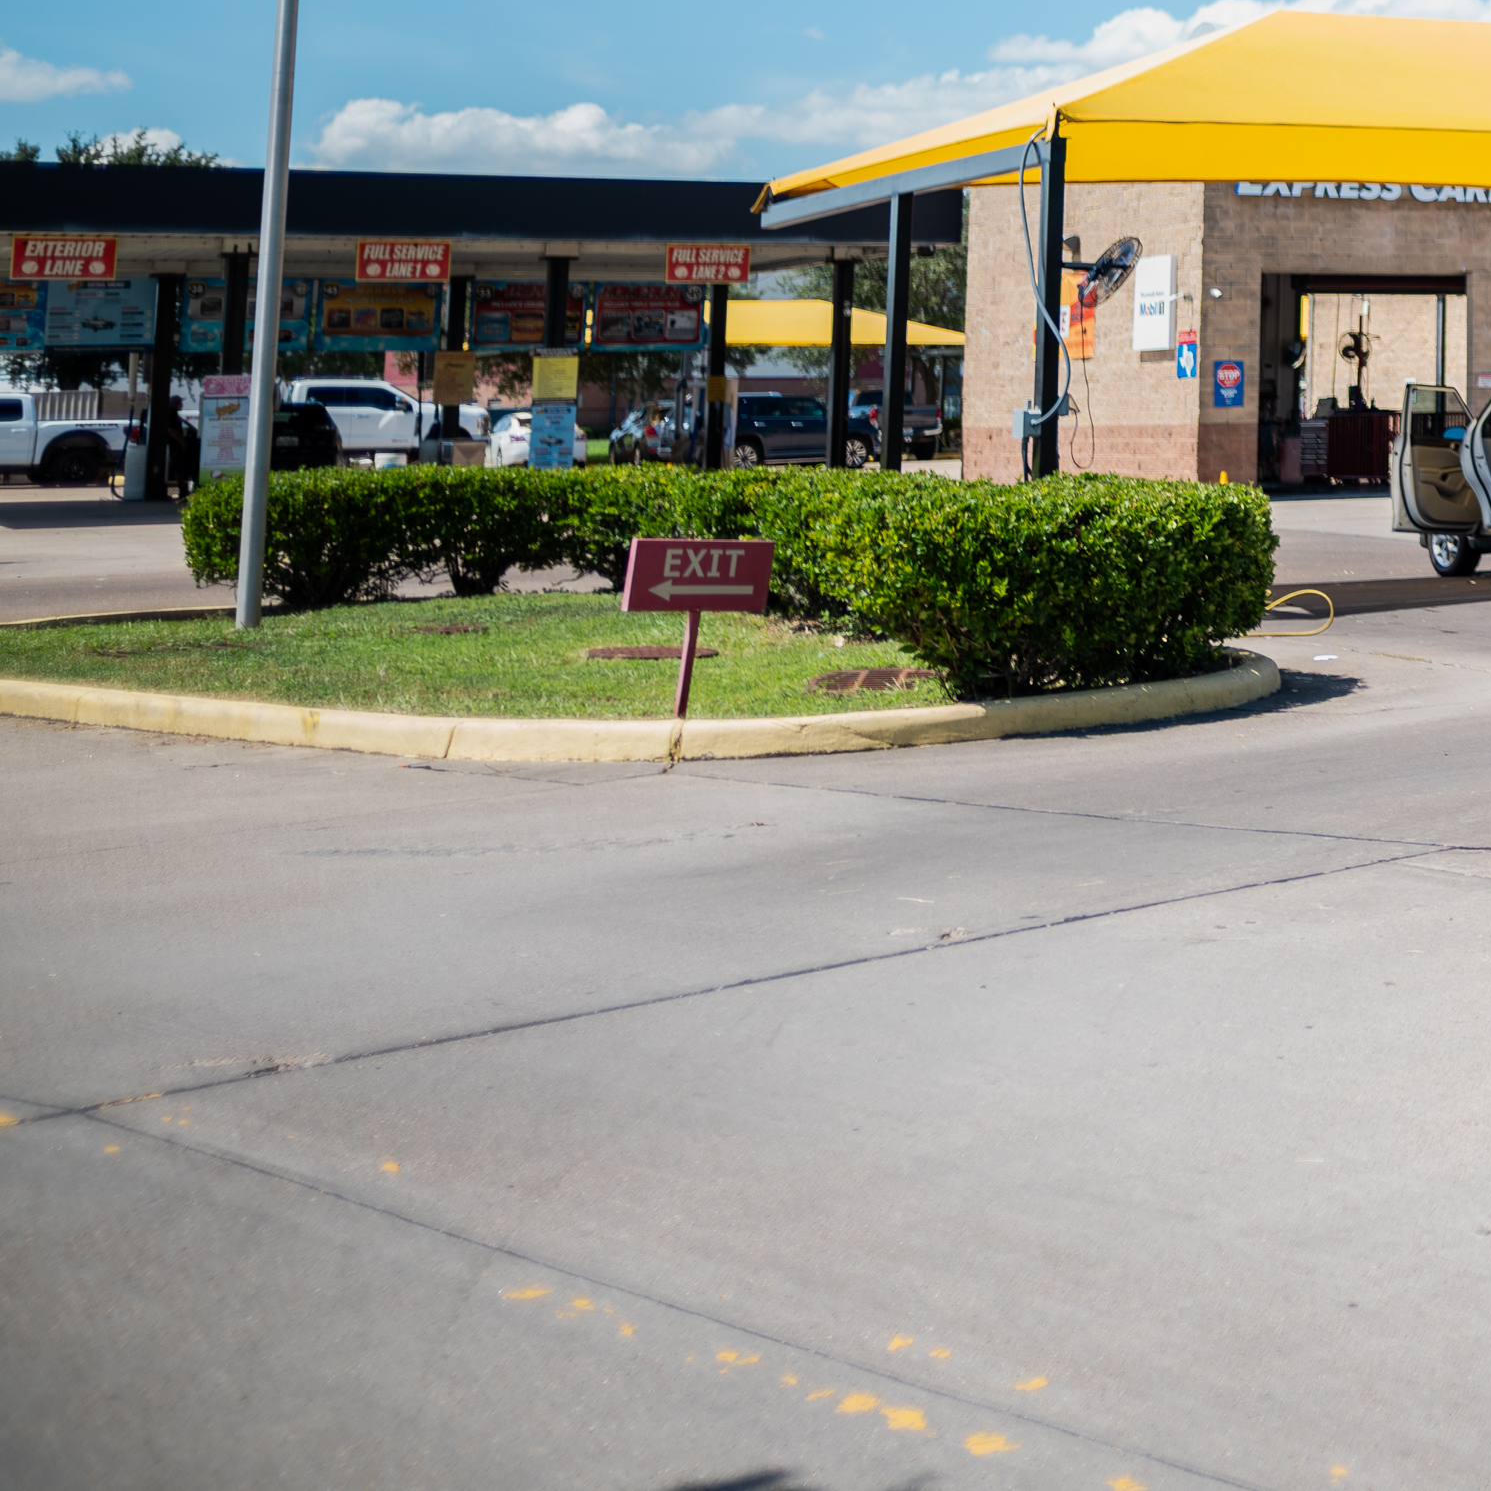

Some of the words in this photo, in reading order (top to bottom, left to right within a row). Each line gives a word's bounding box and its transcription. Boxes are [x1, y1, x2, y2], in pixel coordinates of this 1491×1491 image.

[25, 240, 106, 258] EXTERIOR
[363, 244, 392, 260] FULL
[392, 244, 446, 261] SERVICE
[671, 248, 697, 264] FULL
[698, 248, 746, 265] SERVICE
[43, 259, 85, 276] LANE
[385, 261, 414, 278] LANE
[415, 262, 423, 278] 1
[691, 265, 717, 280] LANE
[718, 265, 726, 280] 2
[1217, 369, 1241, 381] STOP
[663, 548, 746, 579] EXIT
